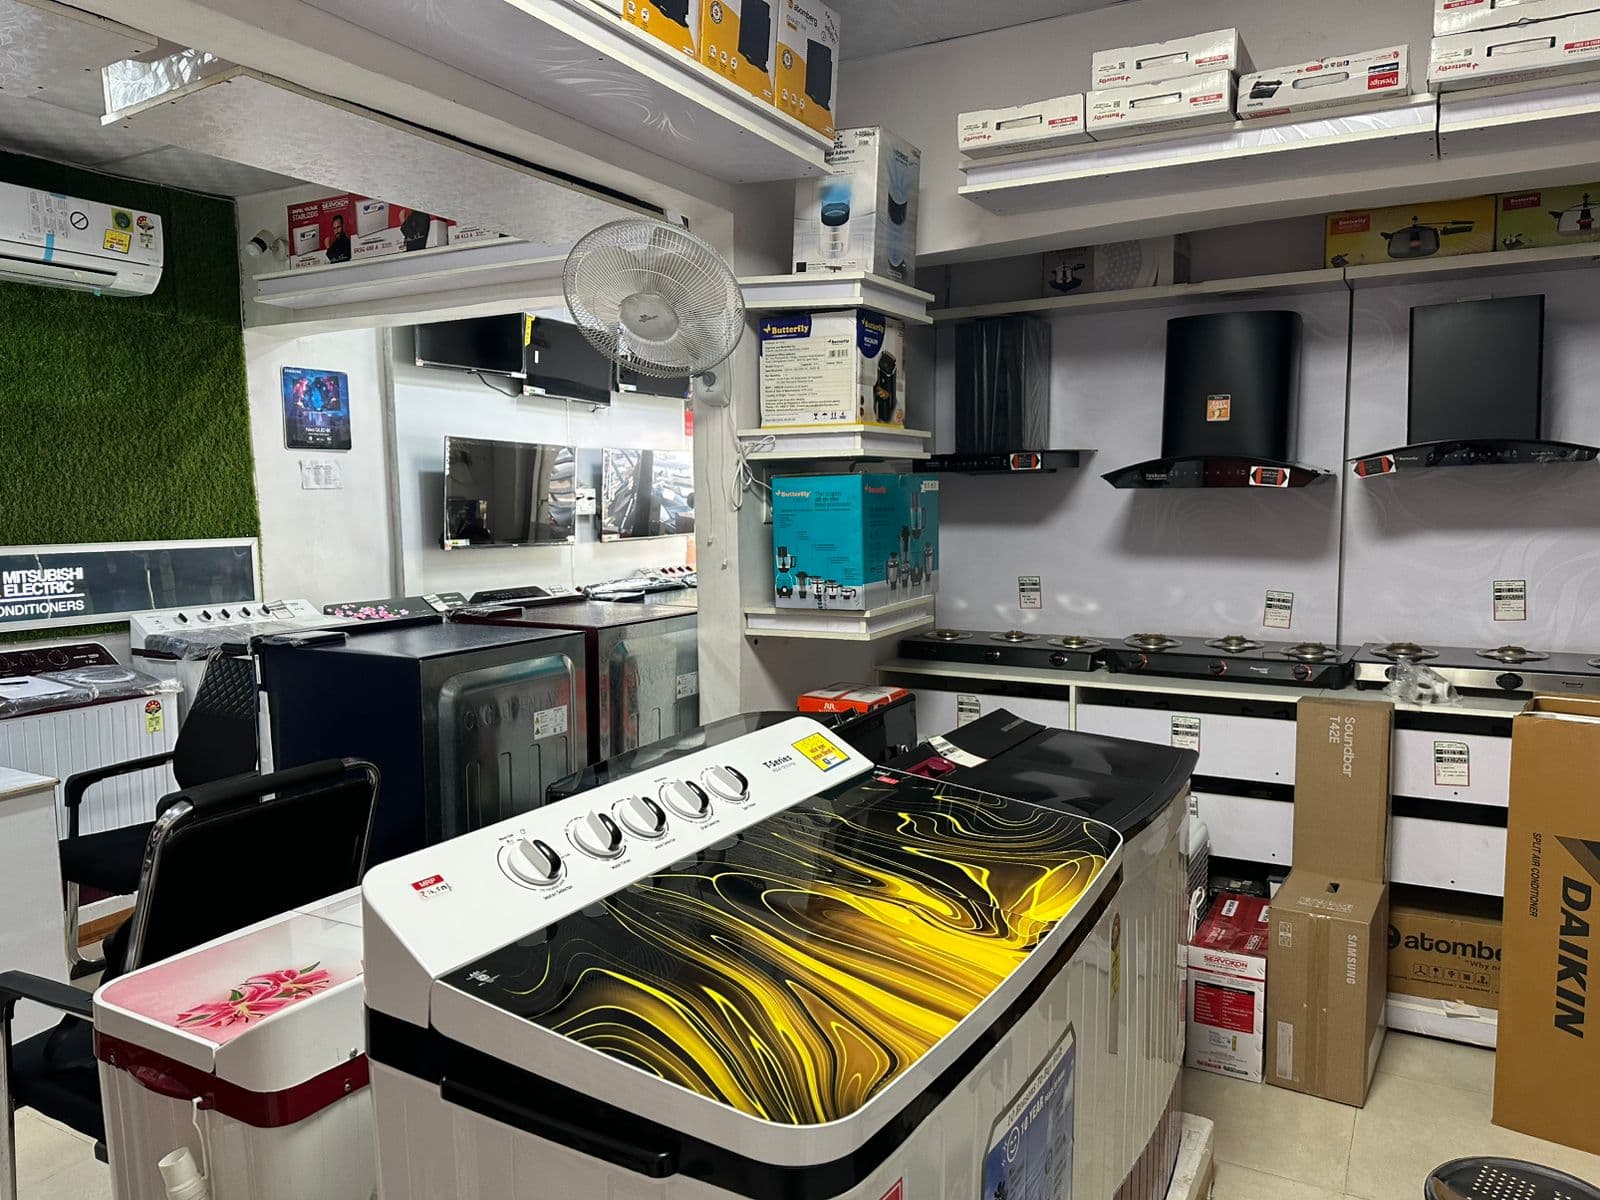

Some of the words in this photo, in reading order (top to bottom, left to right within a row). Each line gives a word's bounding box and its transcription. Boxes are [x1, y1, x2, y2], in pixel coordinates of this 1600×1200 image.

[793, 4, 818, 28] atomberg
[1436, 62, 1471, 73] Butterfly
[1369, 76, 1398, 87] Prestige
[771, 324, 809, 335] Butterfly
[781, 490, 811, 498] Butterfly
[2, 567, 84, 585] MITSUBISHI
[3, 580, 75, 598] ELECTRIC
[1328, 715, 1341, 744] T42E
[1342, 716, 1356, 778] Soundbar
[1532, 832, 1542, 854] SPLIT
[1531, 854, 1541, 867] AIR
[418, 877, 436, 888] MRP
[1529, 867, 1540, 918] CONDITIONER
[1204, 954, 1249, 970] SERVOKON
[1346, 934, 1358, 985] SAMSUNG
[1554, 875, 1592, 1040] DAIKIN
[1028, 1096, 1045, 1123] YEAR
